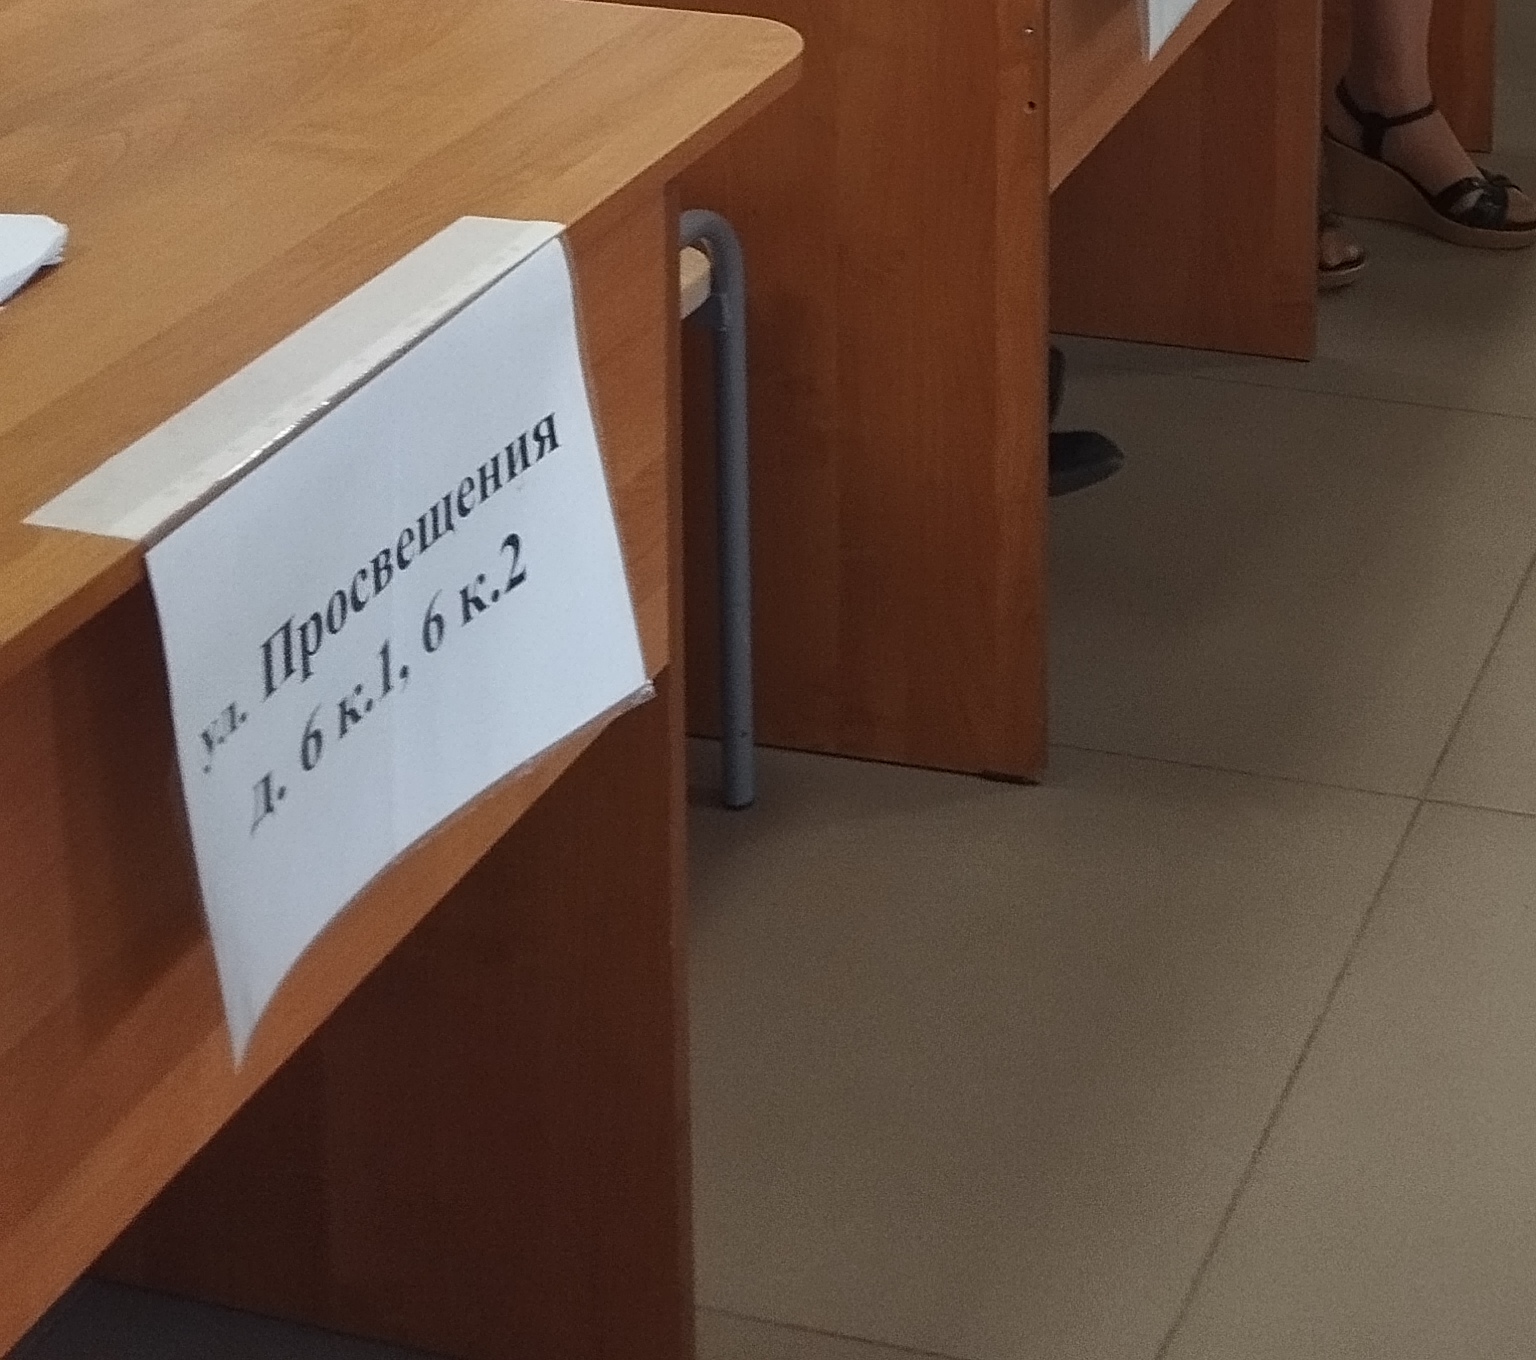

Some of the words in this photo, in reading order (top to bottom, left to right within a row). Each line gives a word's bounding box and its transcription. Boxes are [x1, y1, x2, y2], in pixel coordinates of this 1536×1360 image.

[249, 770, 288, 838] д.
[300, 702, 324, 772] 6
[421, 588, 446, 654] 6
[459, 532, 528, 627] к.2
[260, 411, 560, 702] Просвещения
